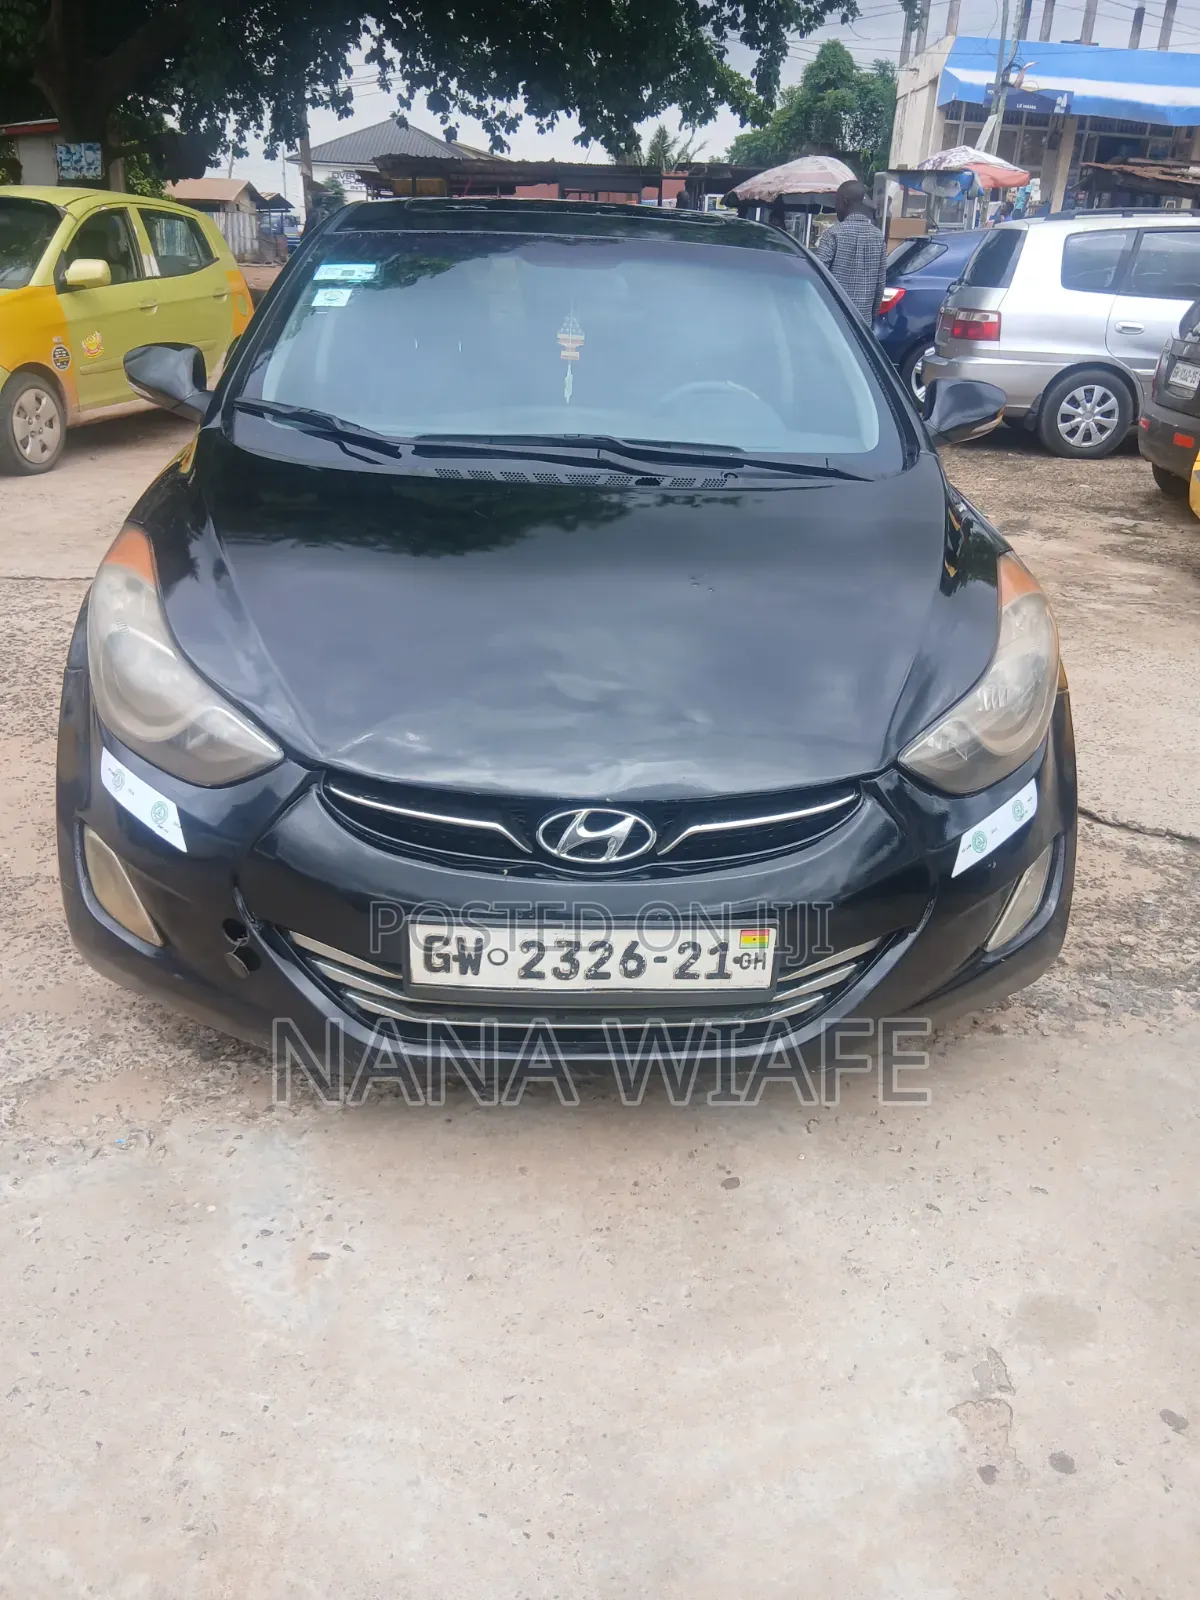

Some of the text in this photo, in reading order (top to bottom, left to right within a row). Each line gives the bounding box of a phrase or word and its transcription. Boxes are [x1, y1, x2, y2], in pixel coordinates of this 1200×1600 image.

[423, 934, 766, 981] GW 2326-21 GH
